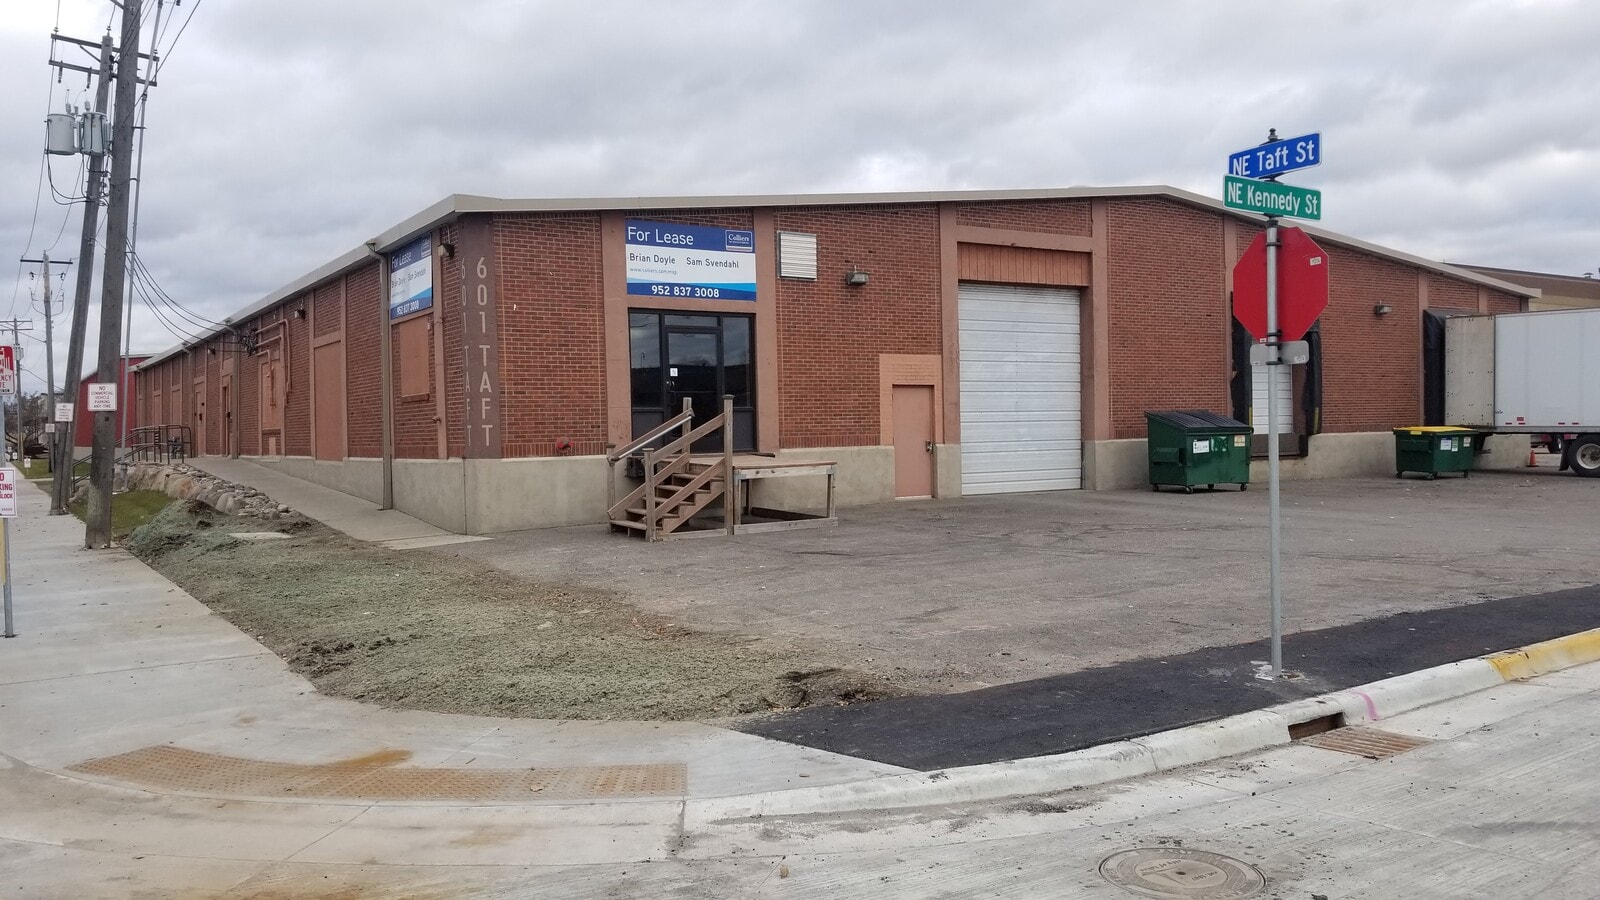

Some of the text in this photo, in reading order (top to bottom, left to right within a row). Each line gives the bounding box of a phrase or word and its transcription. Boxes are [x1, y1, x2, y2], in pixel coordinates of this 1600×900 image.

[1233, 140, 1315, 176] NE Taft St
[1228, 181, 1318, 216] NE Kennedy St
[628, 226, 694, 245] For Lease
[728, 233, 750, 242] Colliers
[629, 252, 739, 268] Brian Doyle Sam Svendahl
[651, 285, 720, 298] 952 837 3008
[476, 256, 493, 447] 601 TAFT
